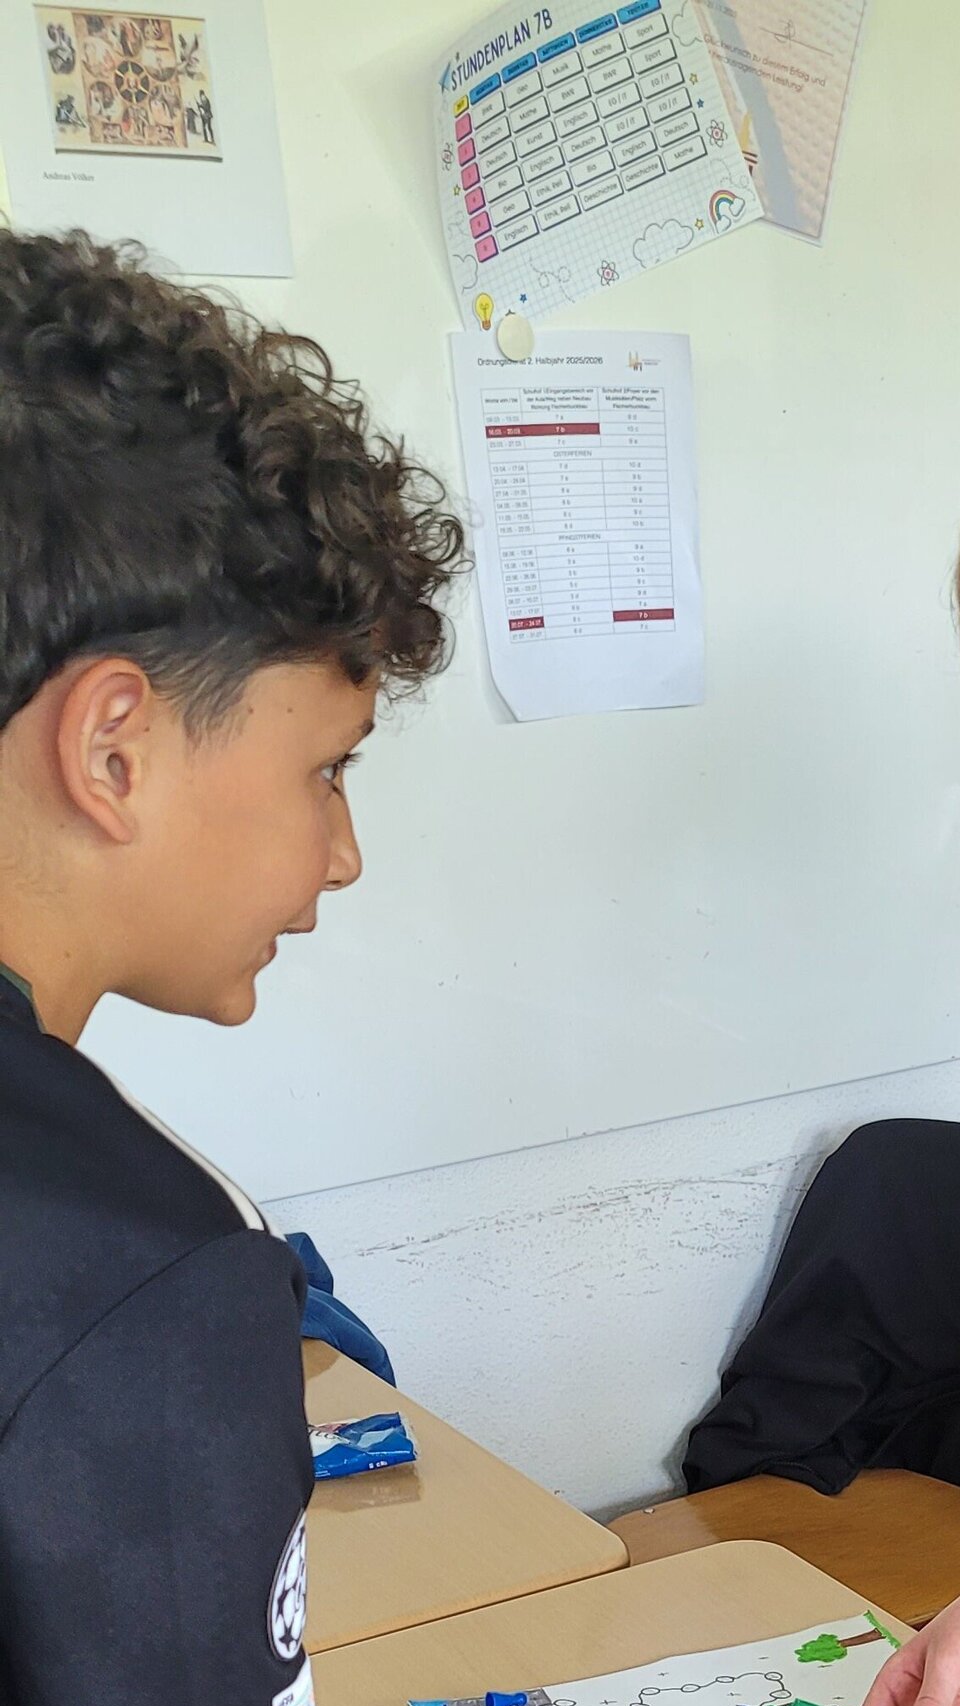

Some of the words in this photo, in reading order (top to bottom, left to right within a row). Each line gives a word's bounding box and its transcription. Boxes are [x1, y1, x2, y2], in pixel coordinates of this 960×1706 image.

[452, 19, 531, 91] STUNDENPLAN
[534, 8, 552, 34] 7B
[536, 356, 564, 367] Halbjahr
